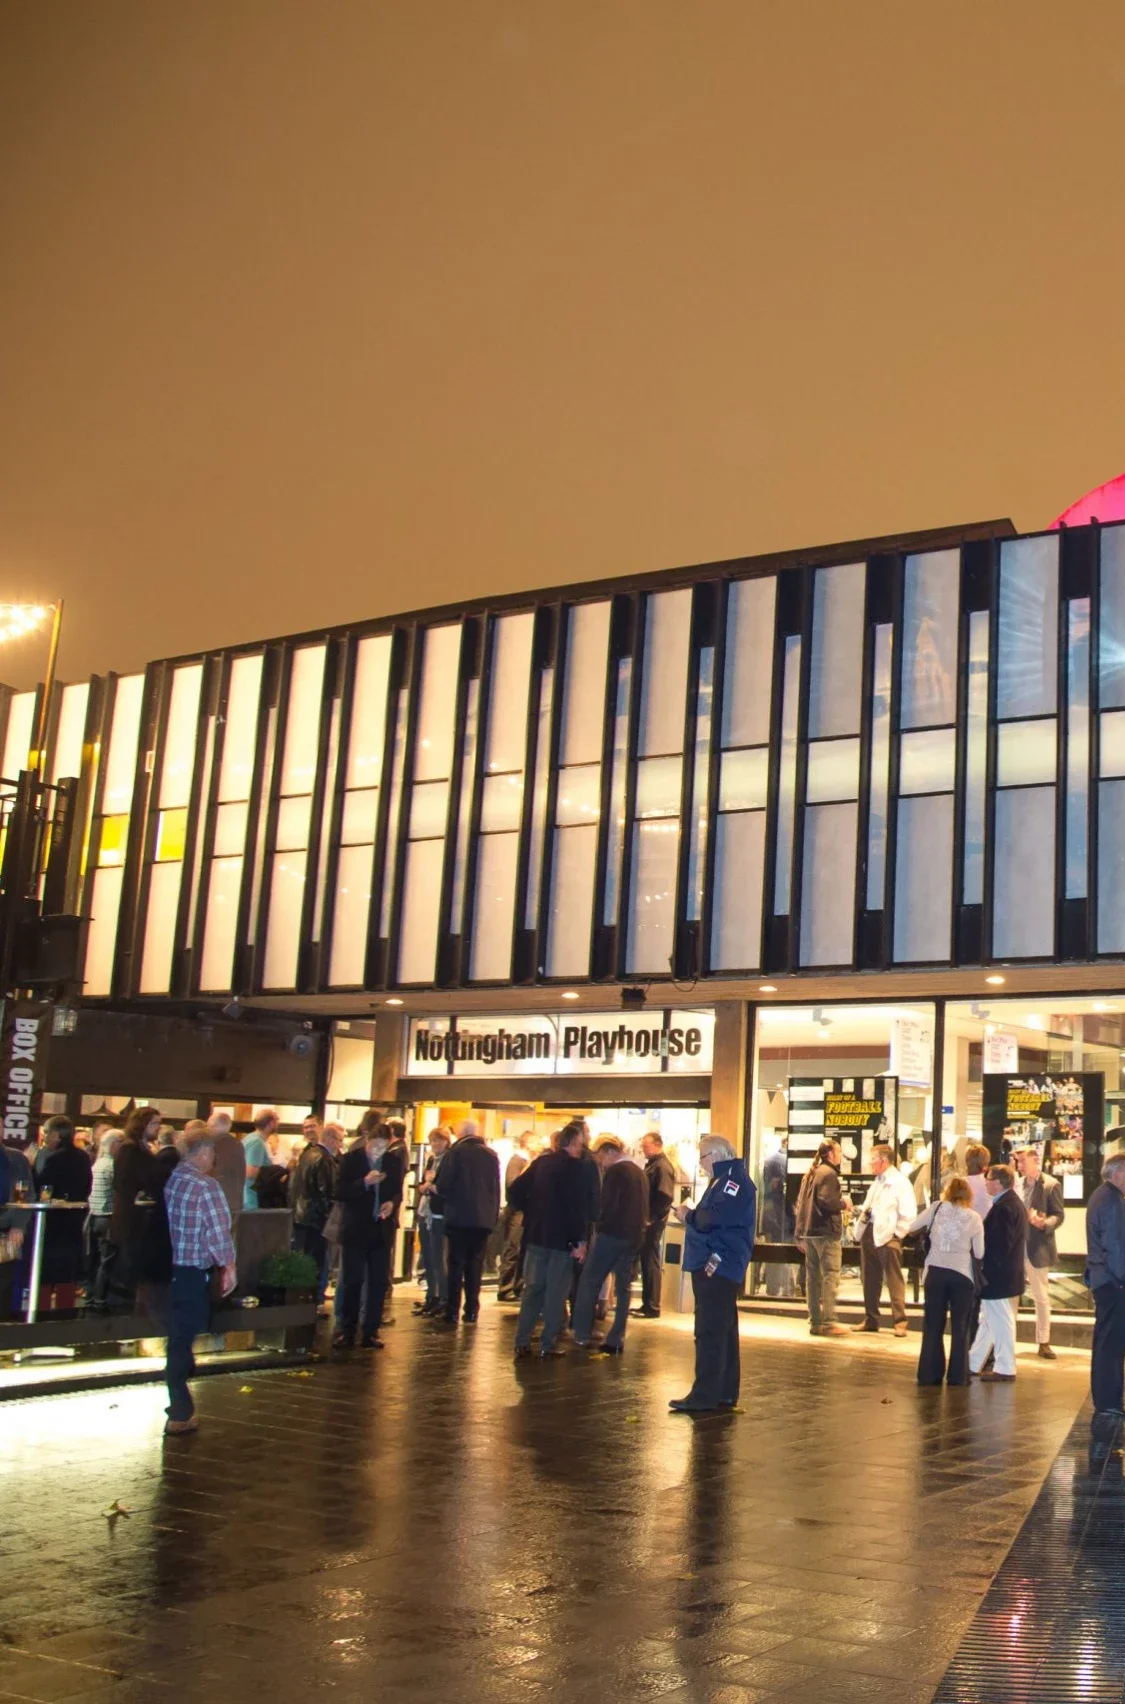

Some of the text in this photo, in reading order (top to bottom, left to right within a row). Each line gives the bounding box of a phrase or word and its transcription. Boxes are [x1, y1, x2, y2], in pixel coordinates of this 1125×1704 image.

[415, 1024, 702, 1065] Nottingham Playhouse
[3, 1018, 39, 1140] BOX OFFICE
[825, 1101, 882, 1113] FOOTBALL
[825, 1114, 871, 1126] NOBODY
